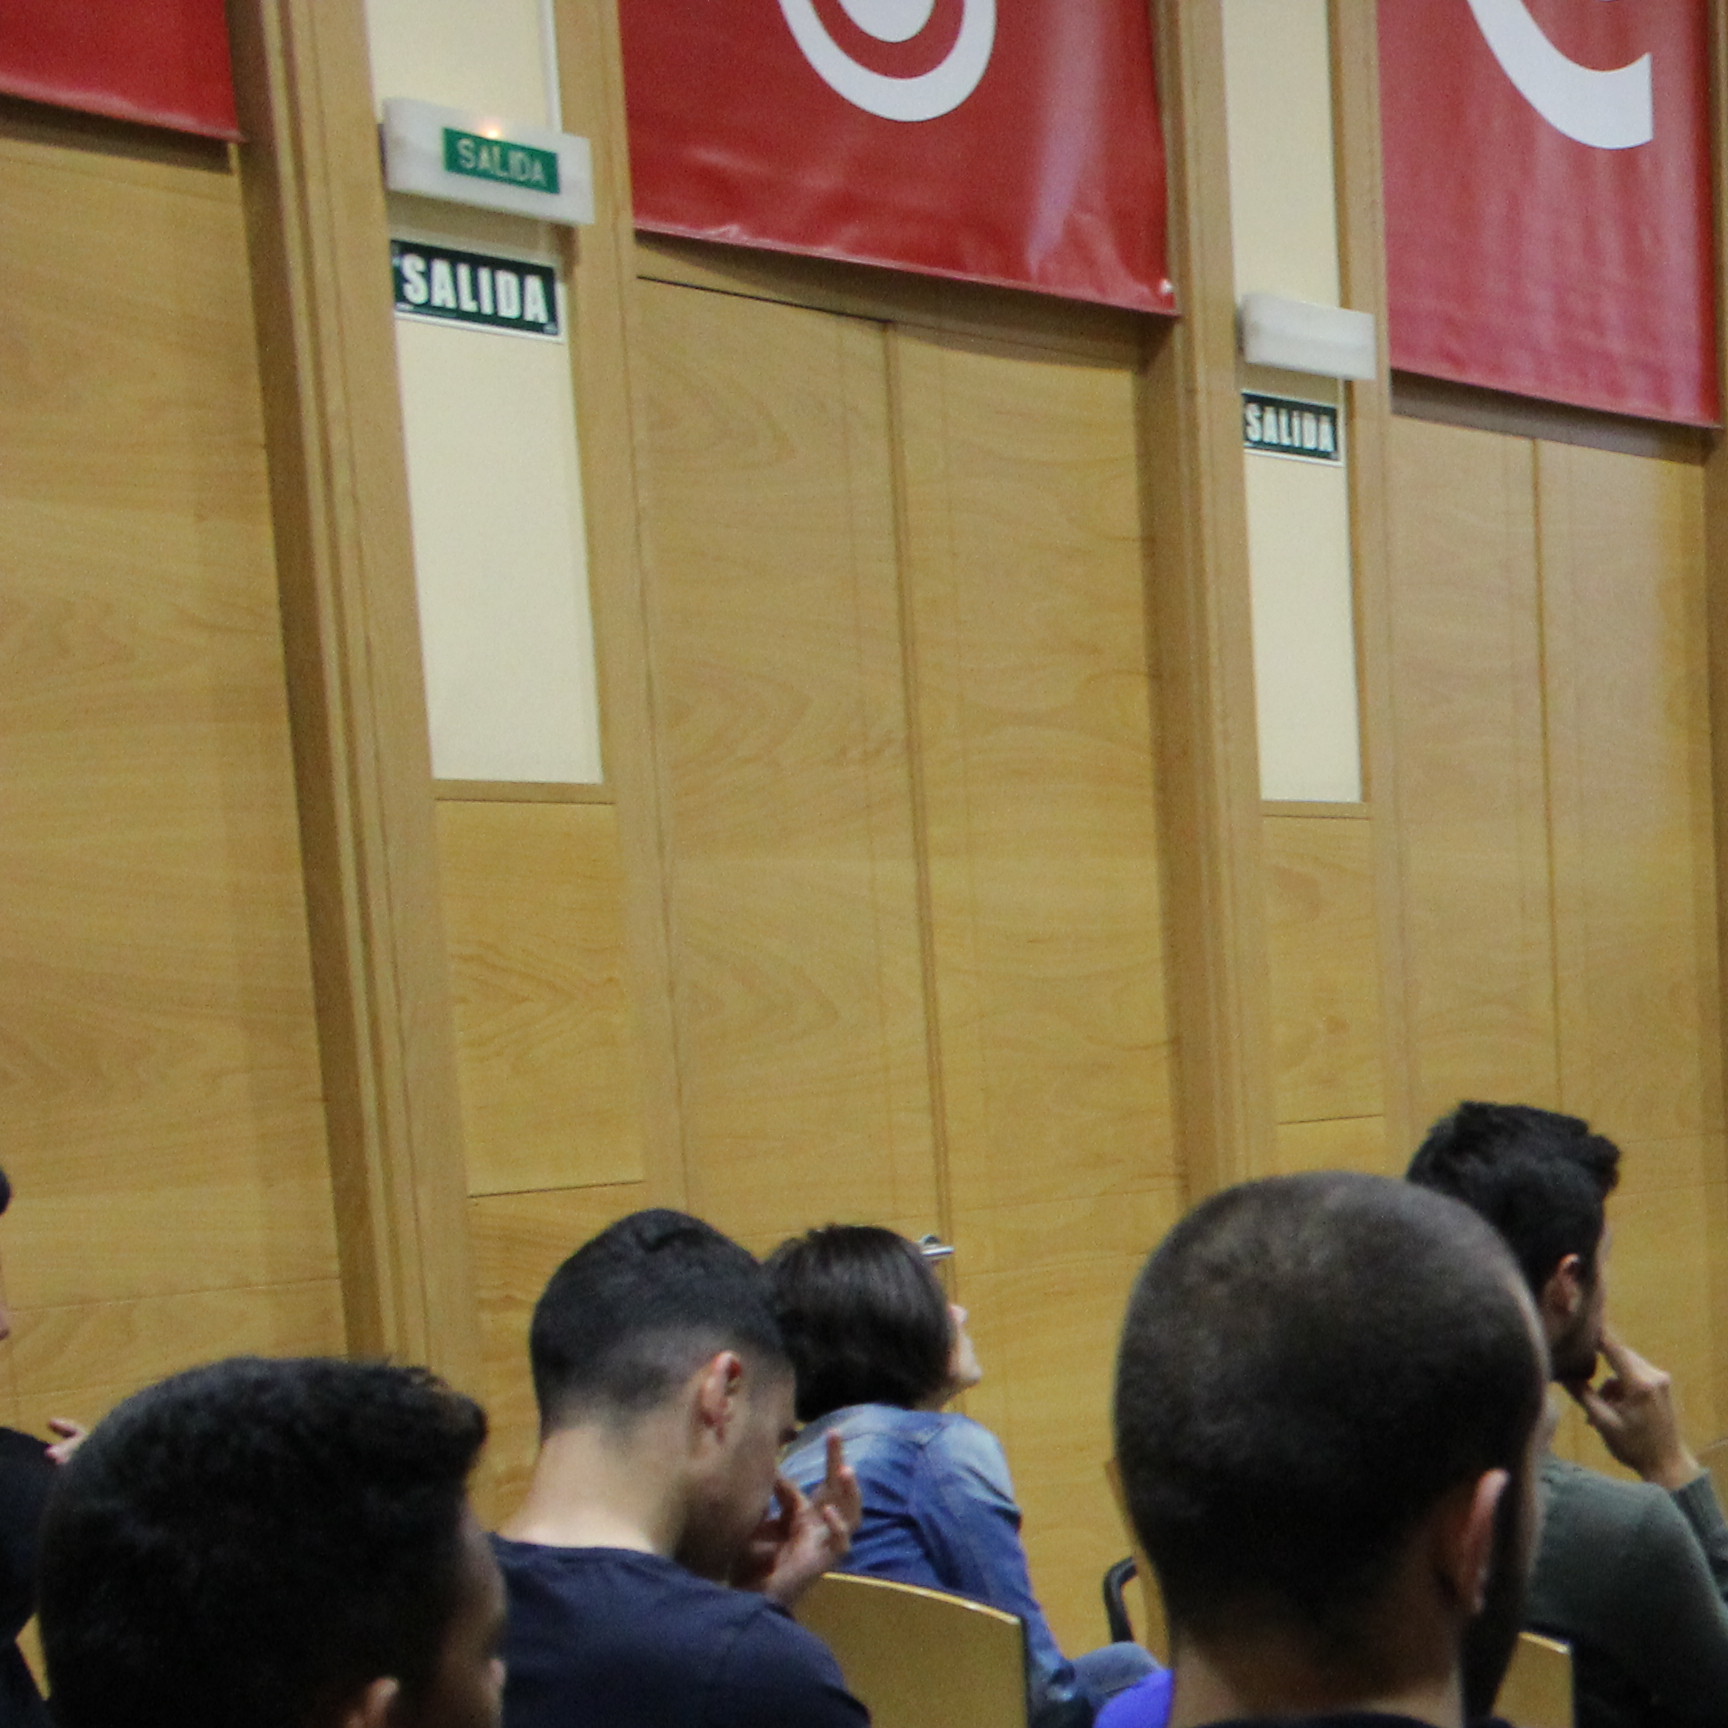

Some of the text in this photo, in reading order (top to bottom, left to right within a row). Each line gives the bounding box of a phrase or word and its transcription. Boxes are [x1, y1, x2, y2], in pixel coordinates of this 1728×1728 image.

[456, 137, 548, 188] SALIDA
[402, 253, 549, 324] SALIDA
[1245, 402, 1335, 453] SALIDA
